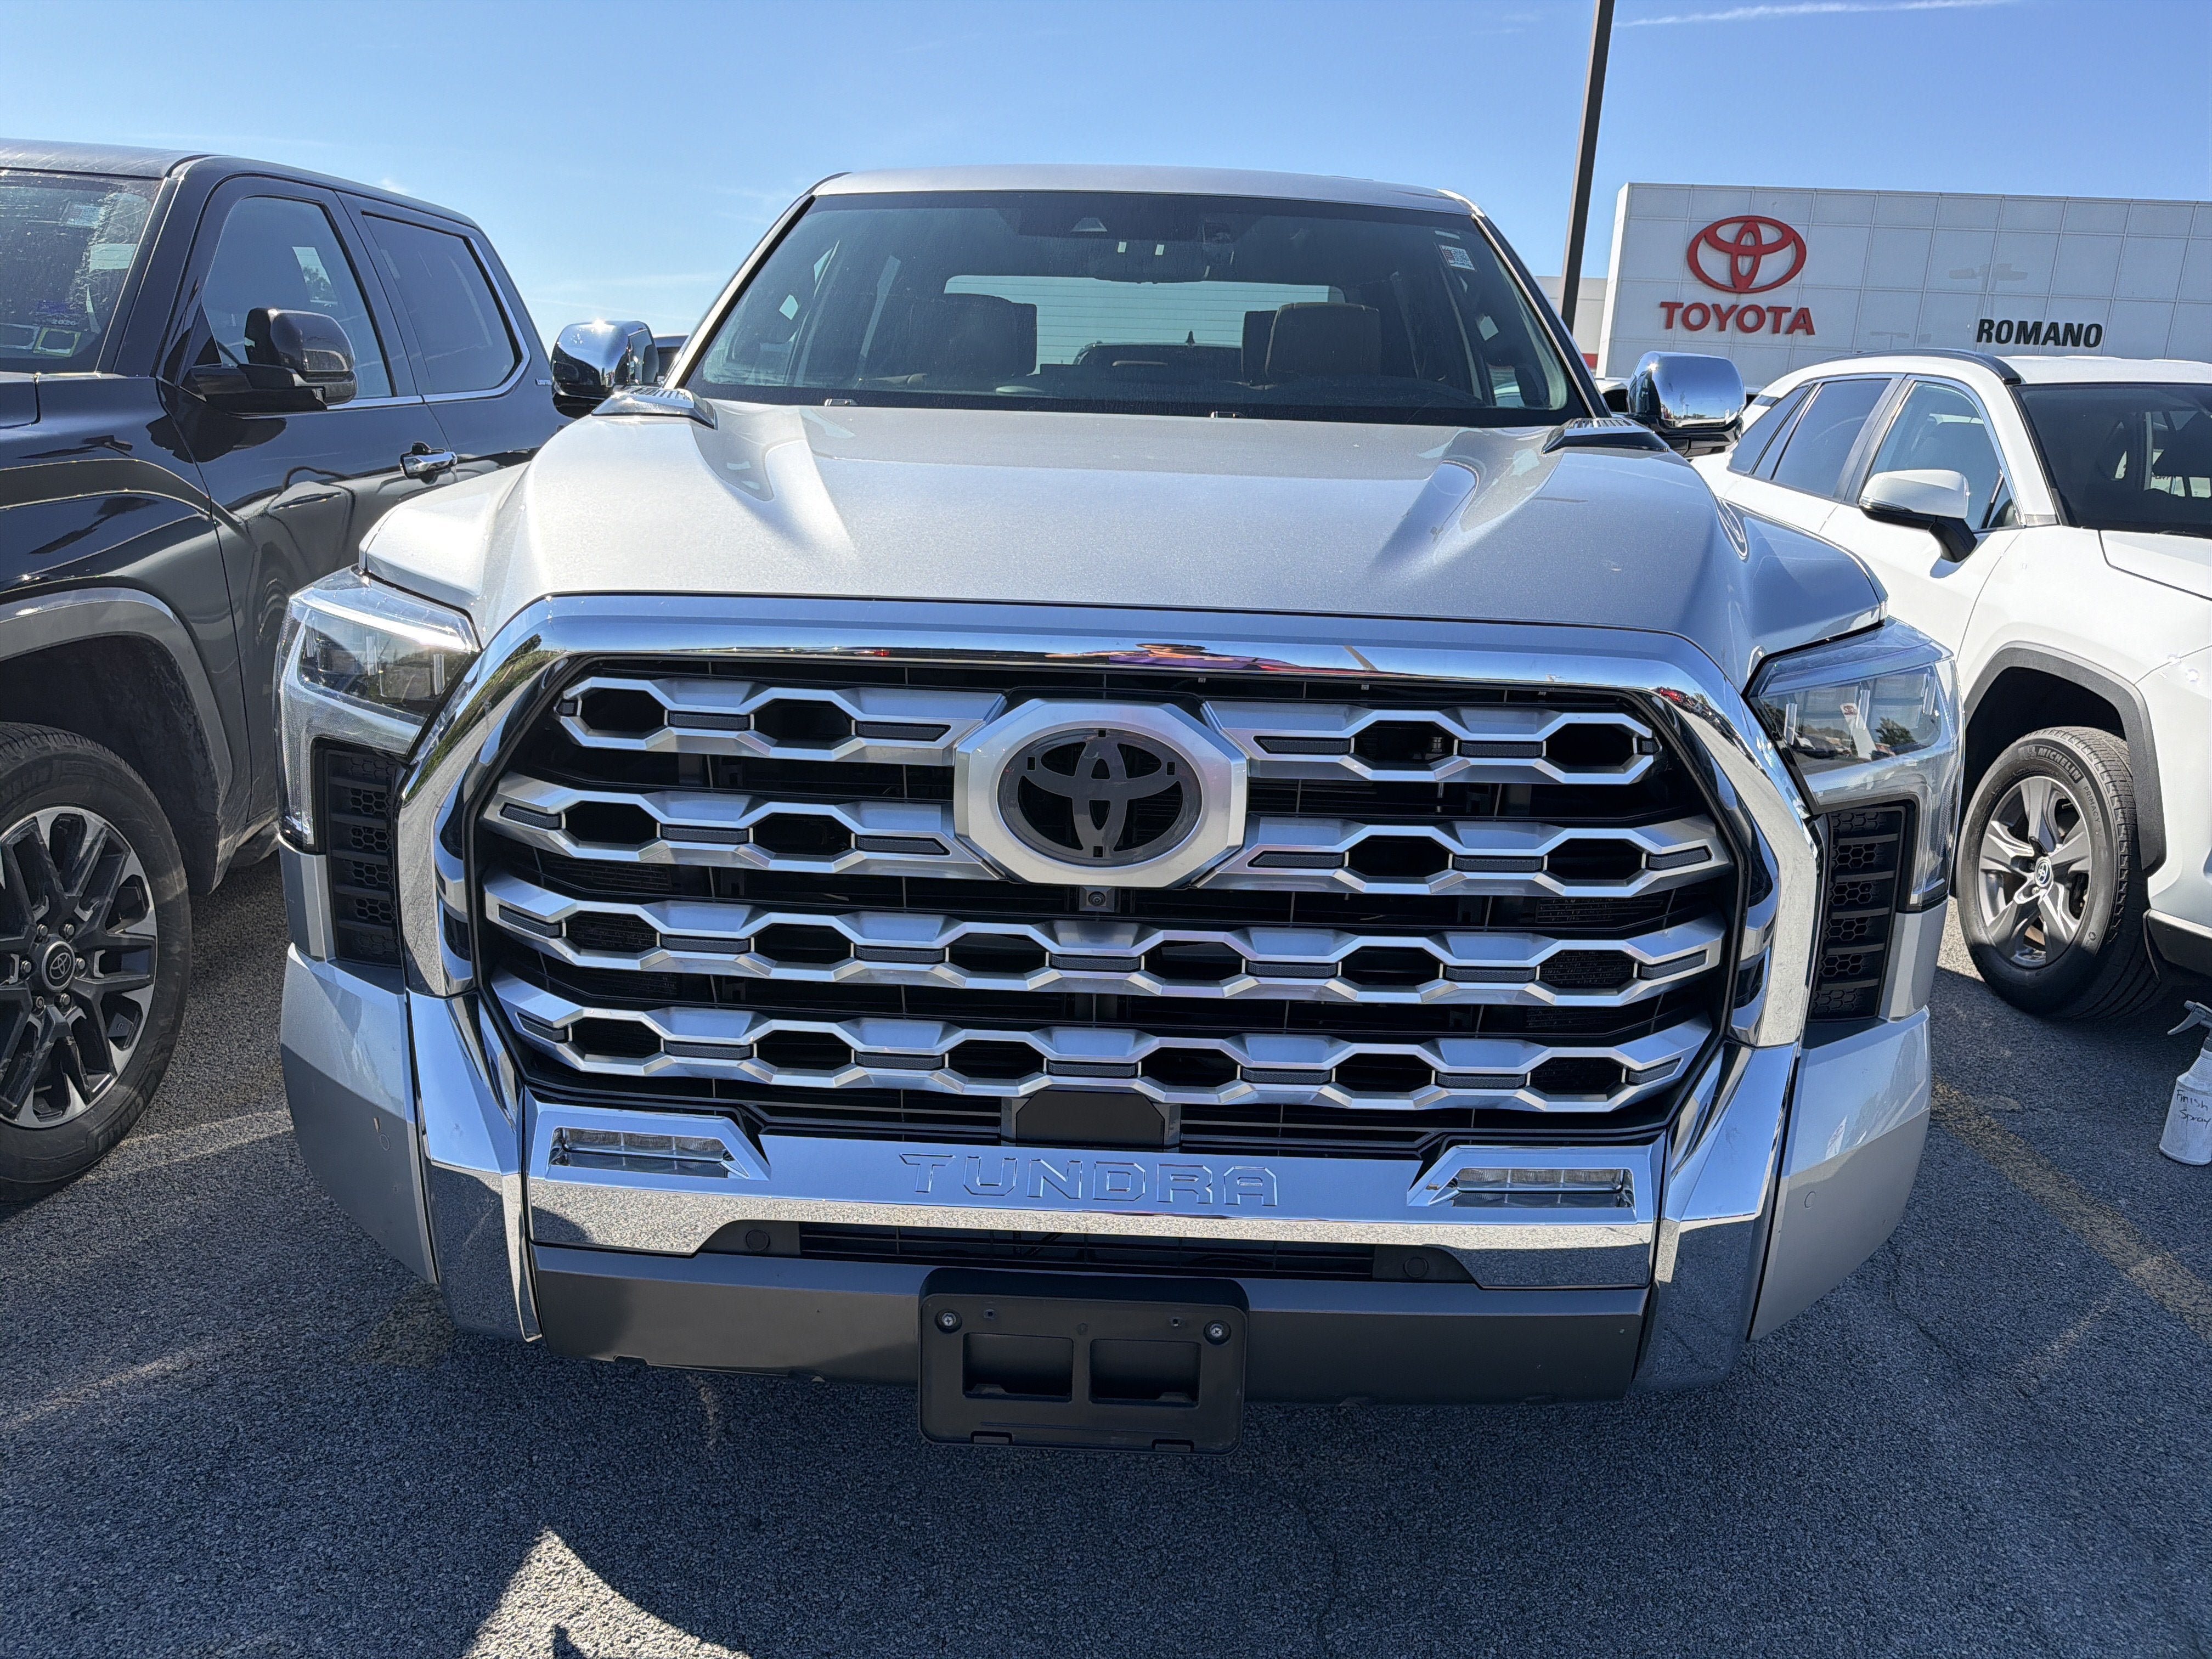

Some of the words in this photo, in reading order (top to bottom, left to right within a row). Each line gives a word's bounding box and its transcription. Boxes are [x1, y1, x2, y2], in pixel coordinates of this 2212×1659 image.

[1659, 301, 1815, 336] TOYOTA
[1976, 318, 2103, 348] ROMANO
[2038, 747, 2082, 781] MICHELIN
[2083, 786, 2101, 823] PRIMACY
[2176, 1089, 2208, 1111] Finish
[2179, 1109, 2211, 1129] Spray
[899, 1153, 1278, 1206] TUNDRA
